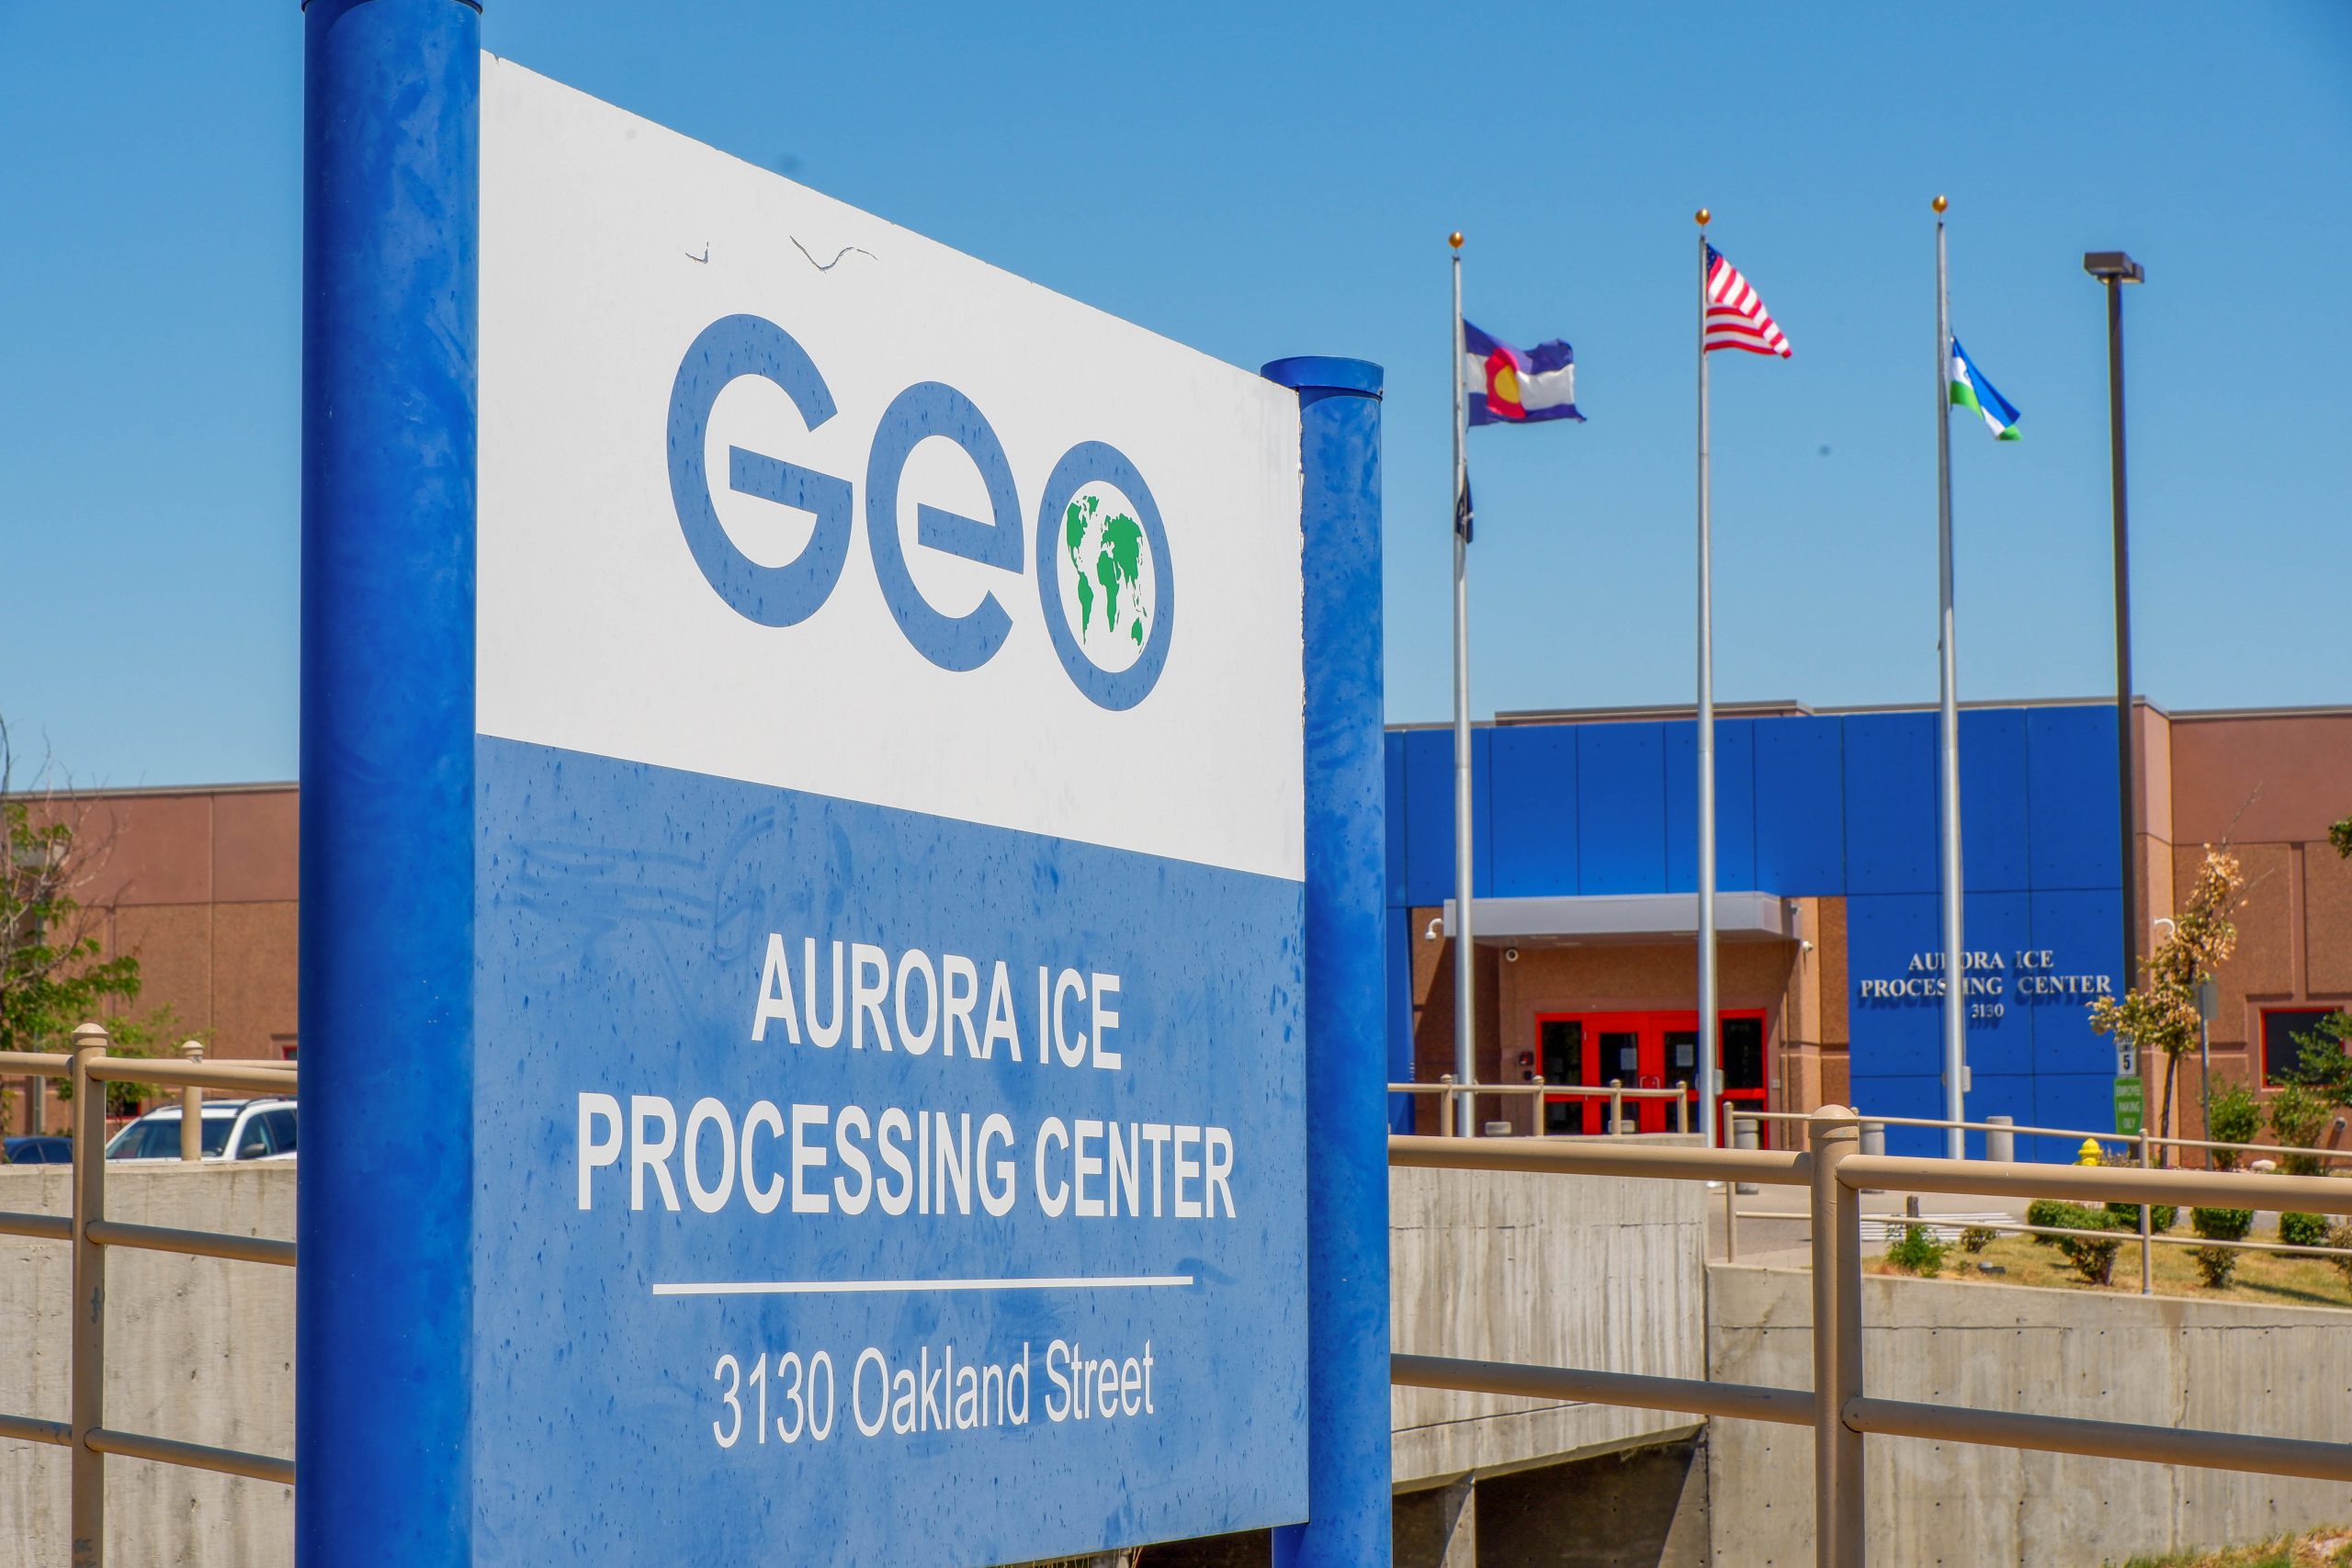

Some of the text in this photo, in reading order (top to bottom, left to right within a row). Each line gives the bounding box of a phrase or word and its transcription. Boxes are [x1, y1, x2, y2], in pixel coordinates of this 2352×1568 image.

[2016, 950, 2054, 969] ICE
[1860, 975, 2112, 998] PROCESING CENTER
[751, 933, 1122, 1070] AURORA ICE
[1971, 1003, 2005, 1019] 3130
[2123, 1054, 2131, 1070] 5
[578, 1091, 1237, 1219] PROCESSING CENTER
[713, 1338, 1154, 1449] 3130 Oakland Street
